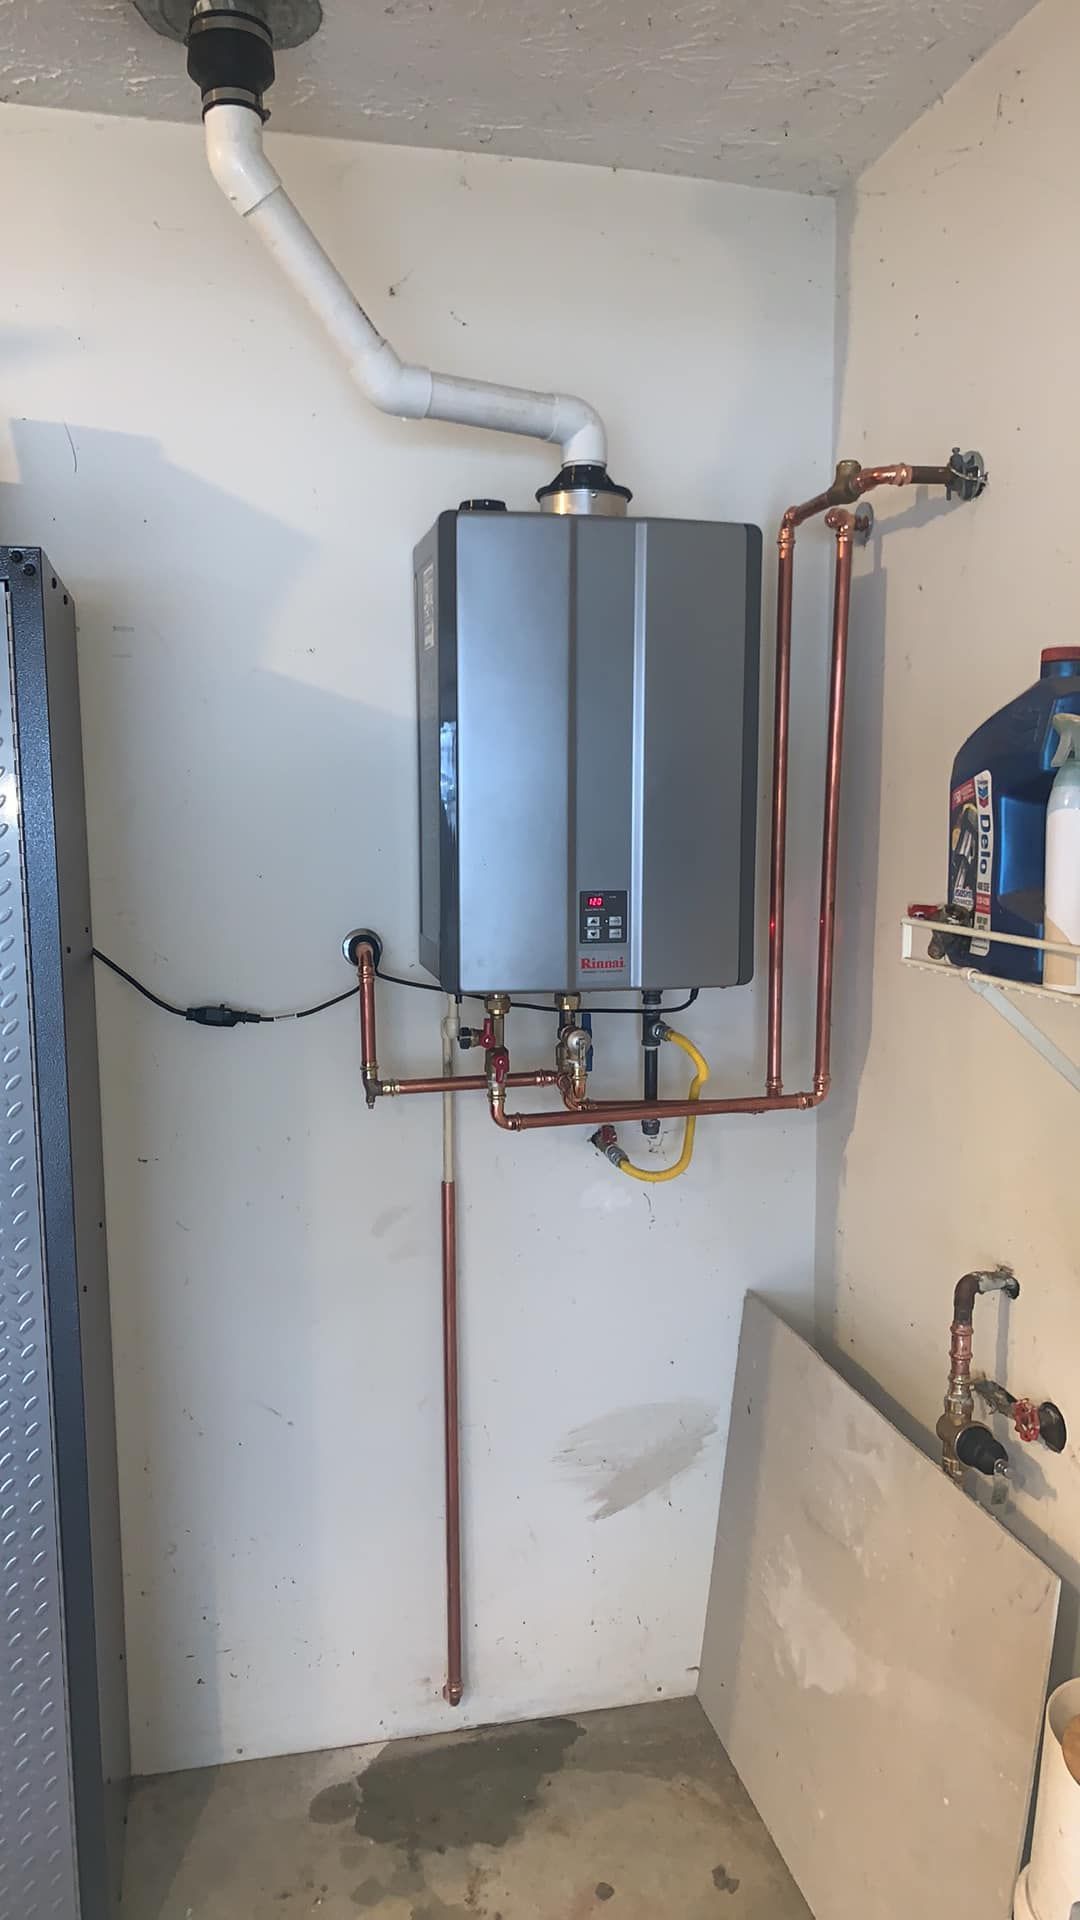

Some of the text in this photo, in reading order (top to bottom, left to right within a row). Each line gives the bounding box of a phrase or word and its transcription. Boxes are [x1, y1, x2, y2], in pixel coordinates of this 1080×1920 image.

[980, 814, 991, 874] Delo
[589, 897, 602, 906] 120
[581, 957, 624, 969] Rinnai
